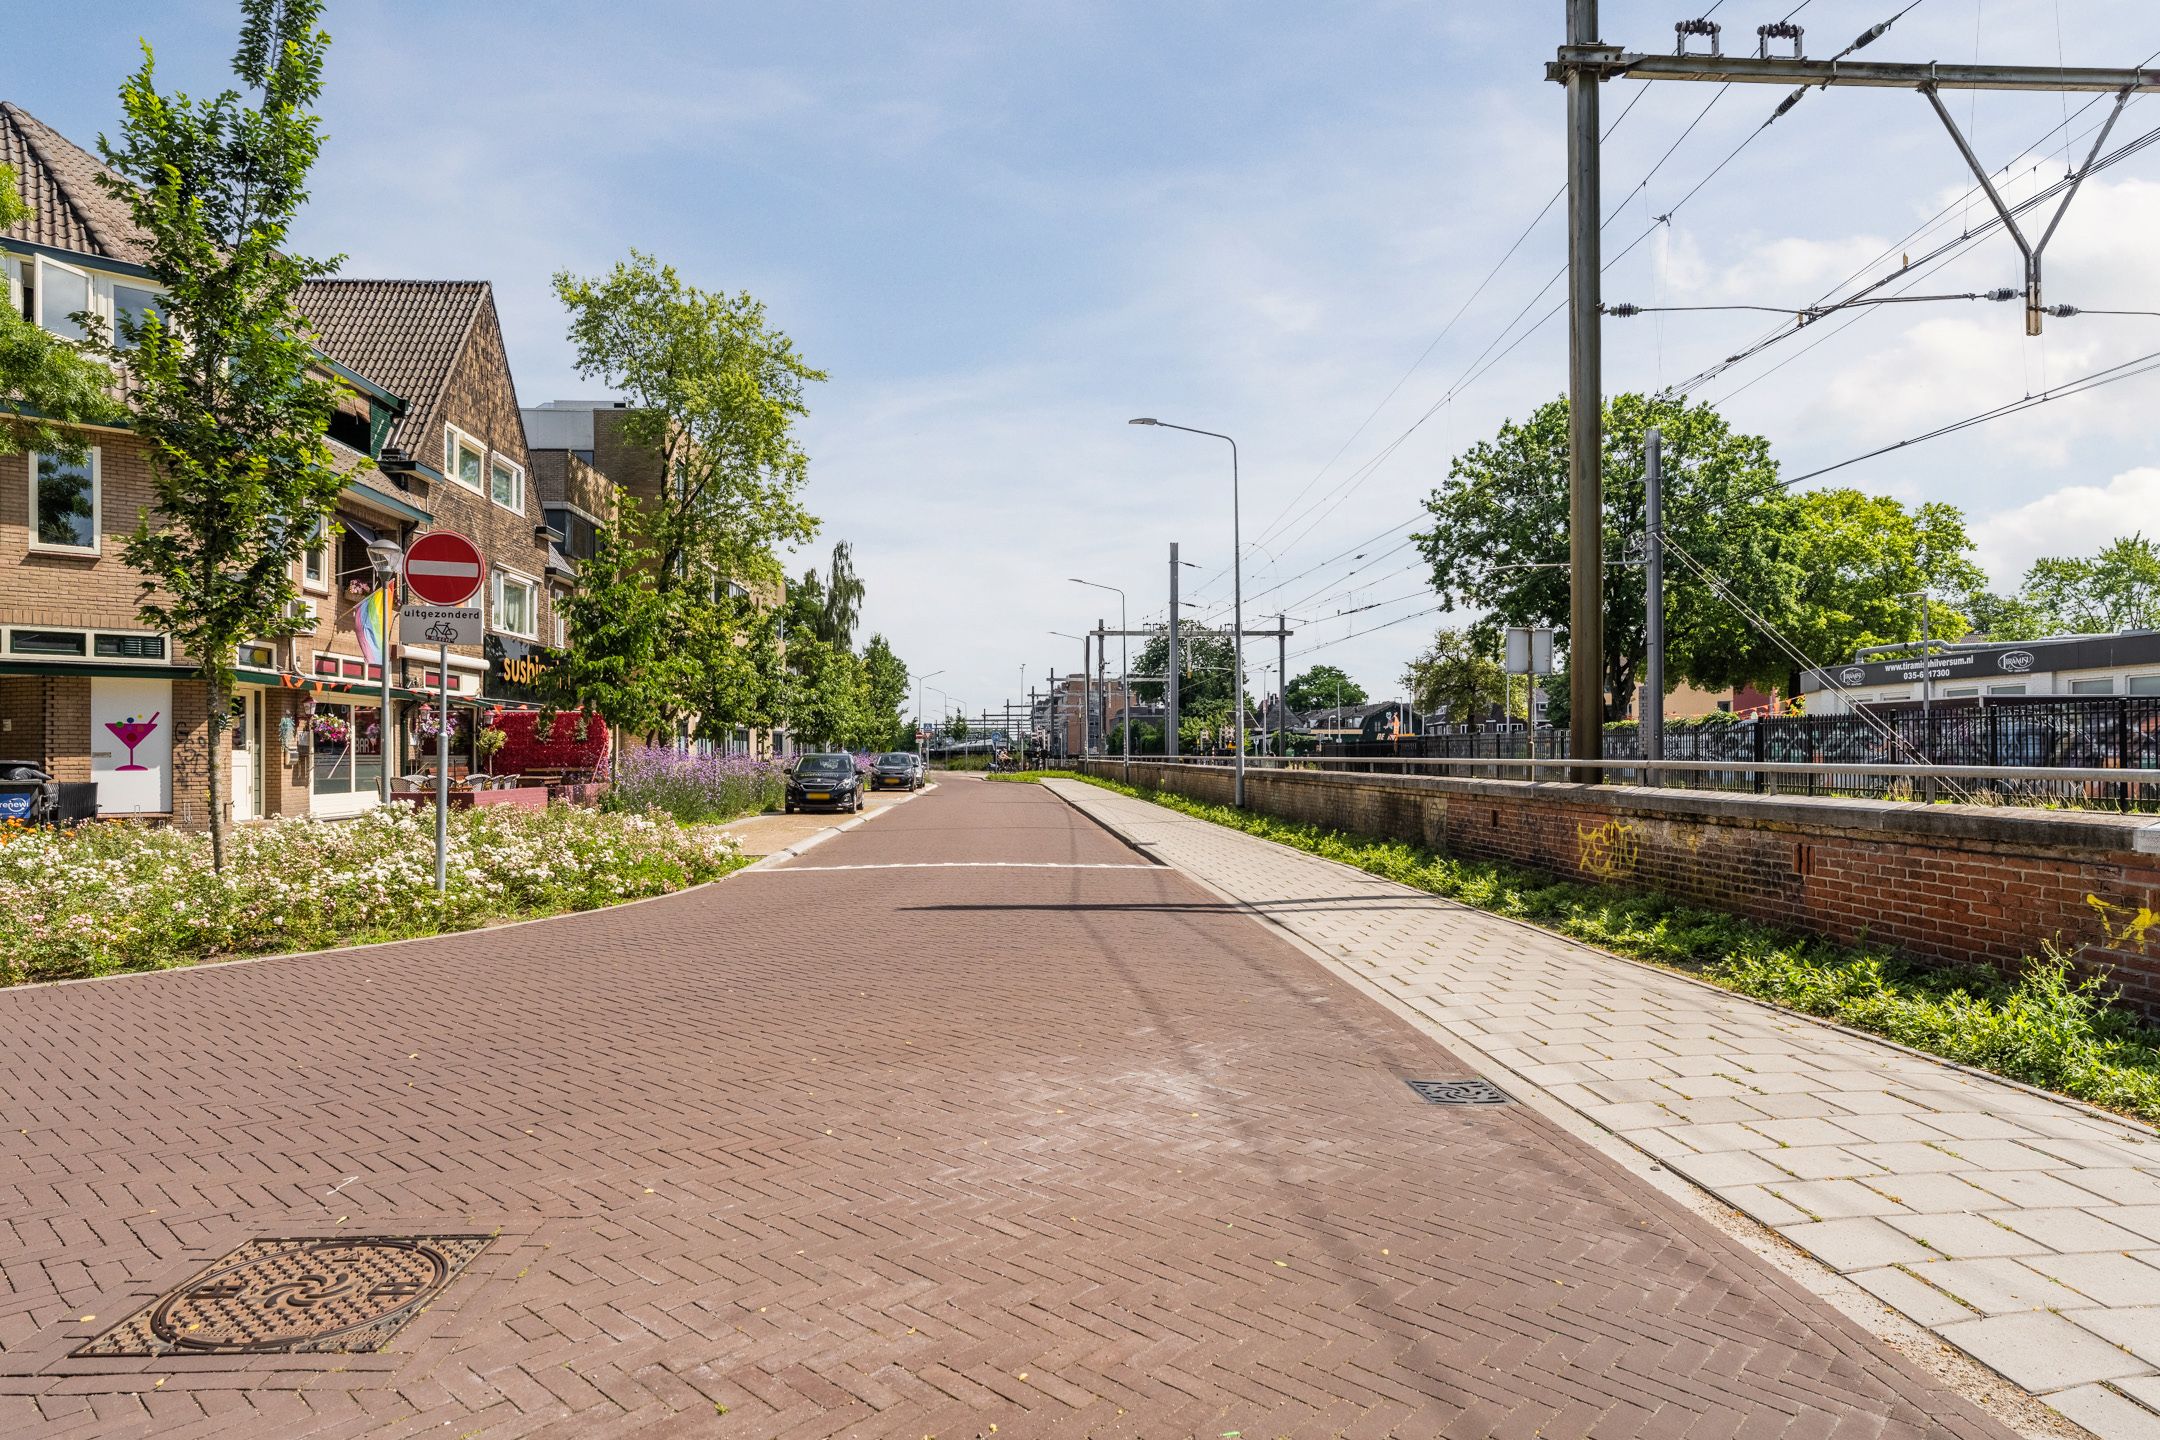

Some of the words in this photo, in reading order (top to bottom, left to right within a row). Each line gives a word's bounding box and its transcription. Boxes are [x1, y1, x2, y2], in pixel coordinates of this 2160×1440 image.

[404, 609, 480, 619] uitgezonderd
[1903, 669, 1950, 680] 035-617300
[355, 738, 370, 753] BAR
